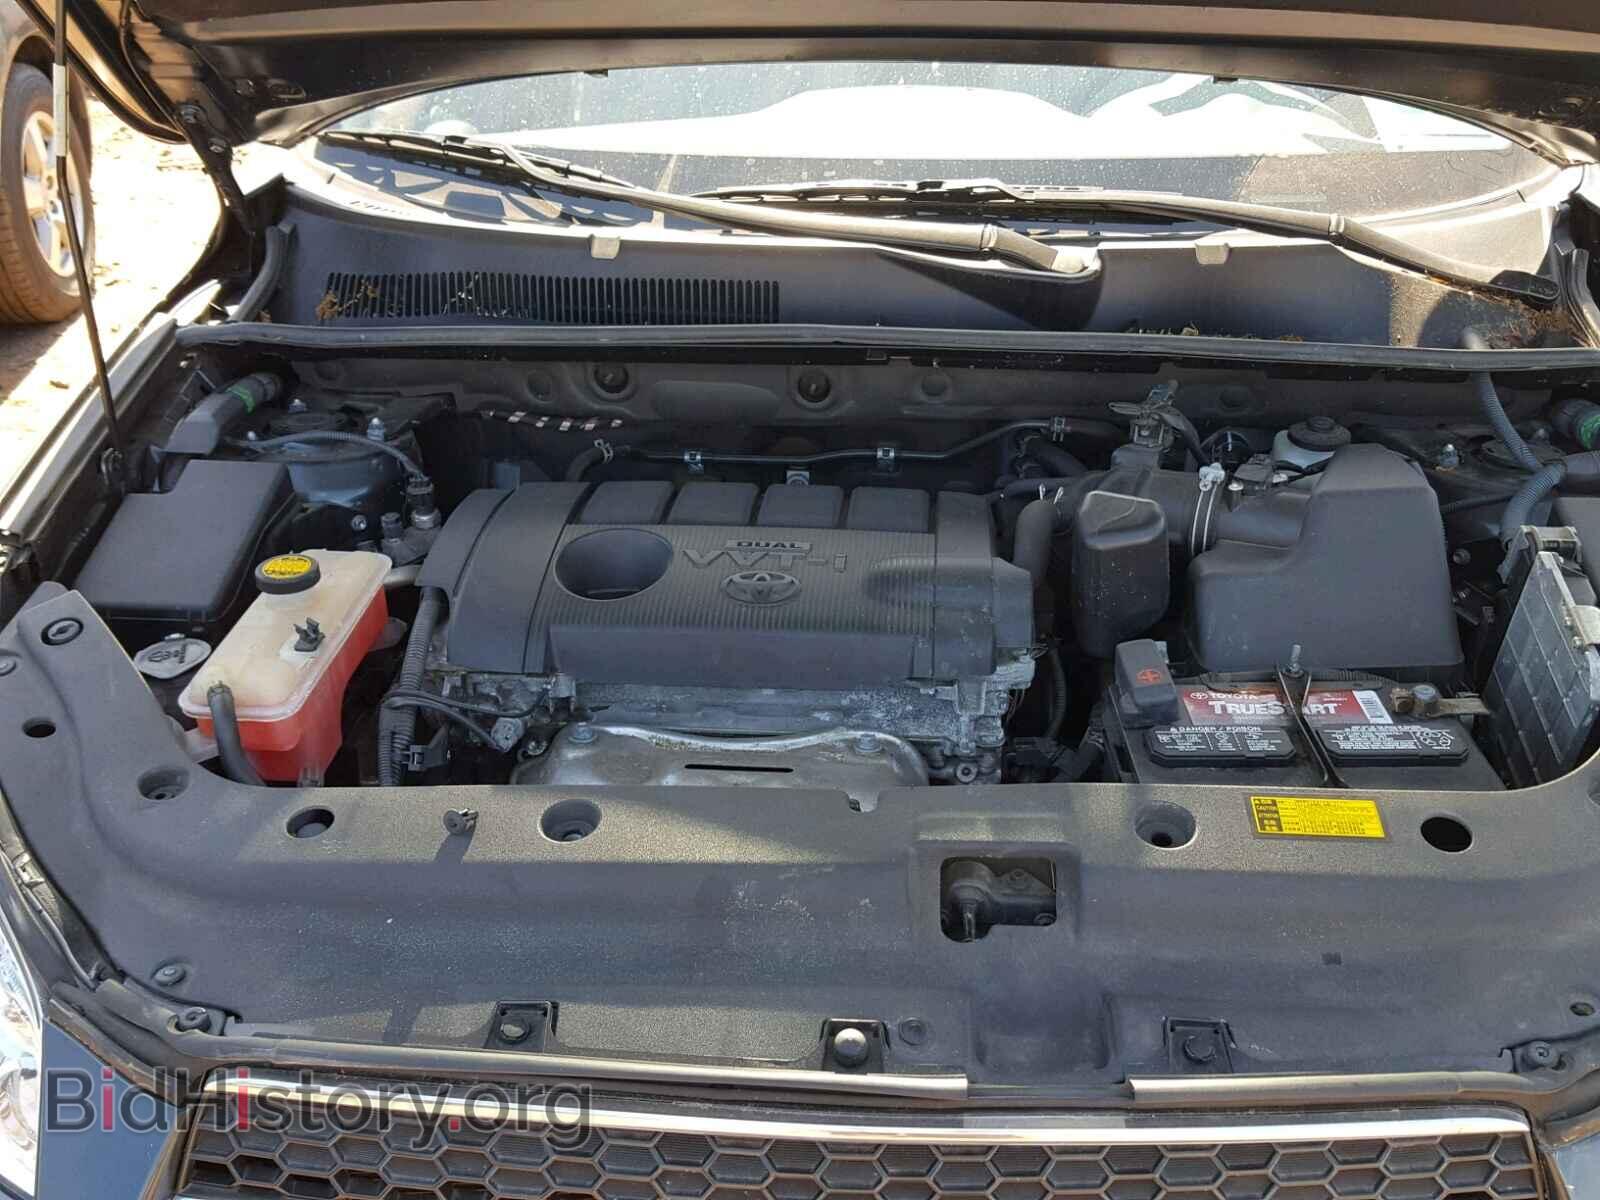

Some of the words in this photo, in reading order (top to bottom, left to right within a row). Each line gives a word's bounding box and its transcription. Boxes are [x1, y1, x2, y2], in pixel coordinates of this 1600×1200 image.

[737, 540, 803, 549] DUAL
[1210, 691, 1259, 701] TOYOTA
[1178, 725, 1218, 733] DANGER
